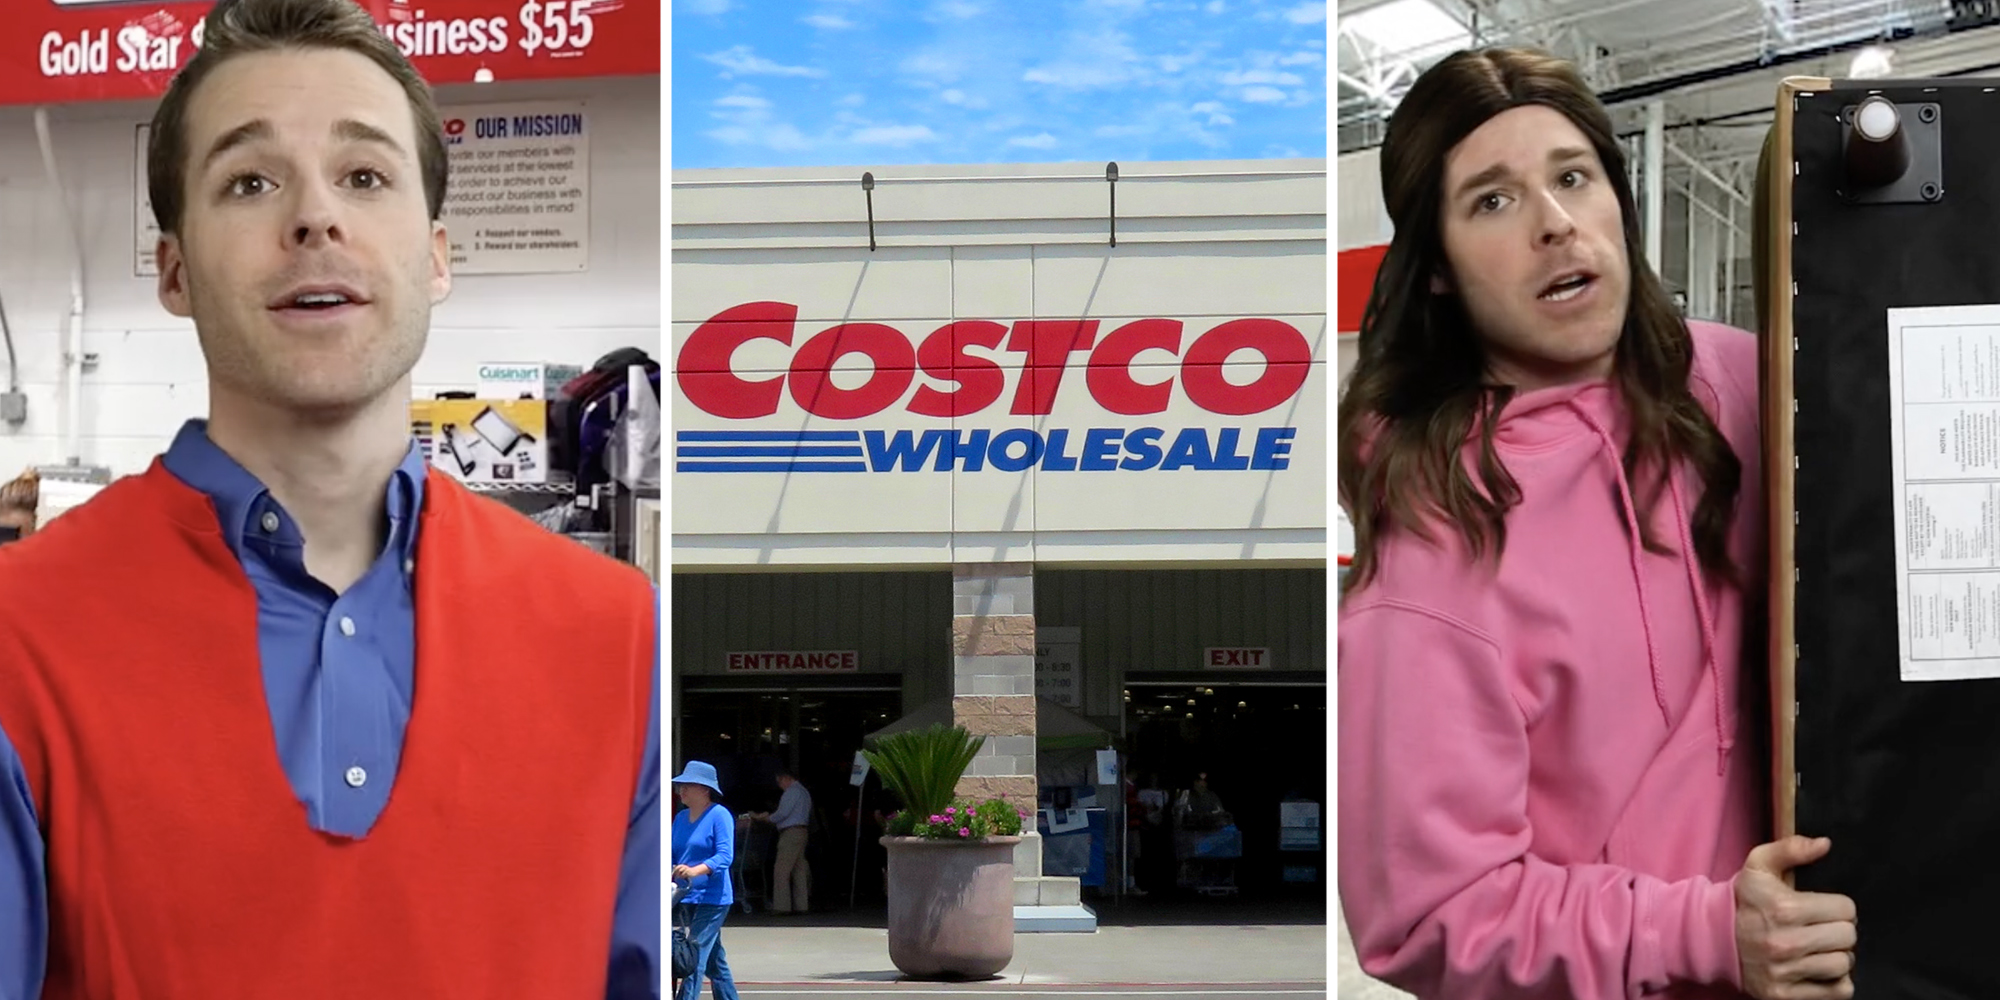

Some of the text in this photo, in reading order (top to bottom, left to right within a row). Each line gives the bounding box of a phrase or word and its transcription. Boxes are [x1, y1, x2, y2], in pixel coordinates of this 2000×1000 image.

[378, 0, 594, 57] siness $55
[40, 28, 109, 76] Gold
[116, 24, 183, 72] Star
[475, 117, 508, 139] OUR
[513, 113, 583, 137] MISSION
[456, 163, 501, 174] services
[446, 191, 484, 202] onduct
[507, 189, 557, 200] business
[479, 366, 539, 379] Cuisinart
[677, 301, 1312, 420] COSTCO
[865, 427, 1297, 473] WHOLESALE
[1939, 428, 1947, 454] NOTICE
[729, 652, 855, 670] ENTRANCE
[1211, 649, 1265, 666] EXIT
